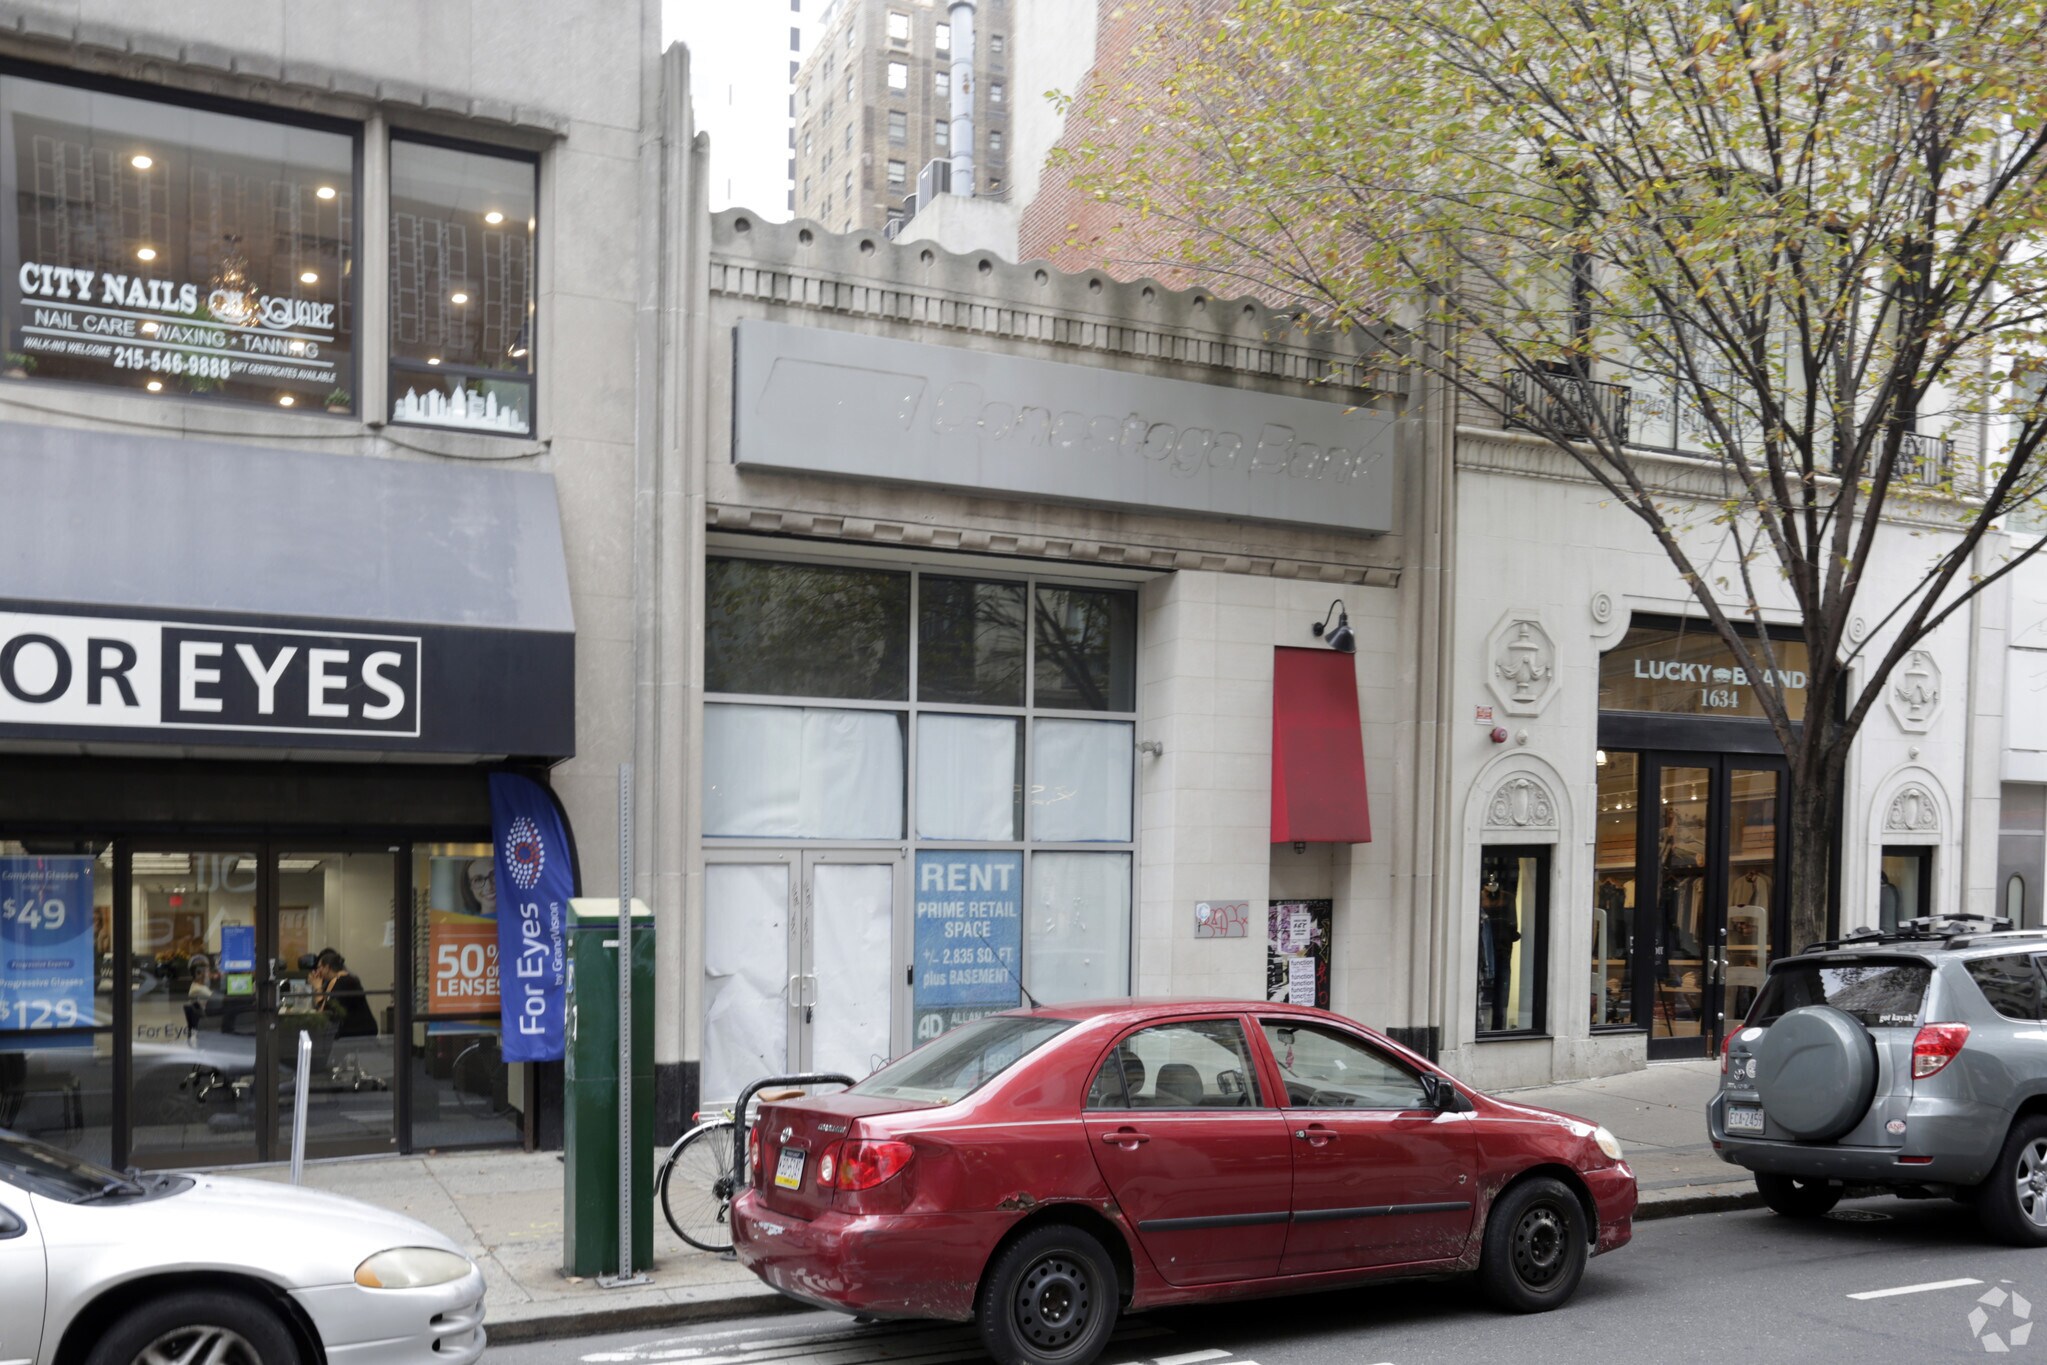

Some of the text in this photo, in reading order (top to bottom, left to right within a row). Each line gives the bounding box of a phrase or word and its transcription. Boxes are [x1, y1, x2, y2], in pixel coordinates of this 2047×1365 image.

[19, 261, 95, 301] CITY
[102, 272, 198, 314] NAILS
[256, 294, 335, 331] SQUARE
[34, 308, 79, 331] NAIL
[83, 314, 136, 337] CARE
[155, 324, 227, 349] WAXING
[23, 336, 113, 358] WALK-INS WELCOME
[114, 346, 231, 380] 215-546-9888
[231, 360, 337, 384] GIFT CERTIFICATES AVAILABLE
[0, 633, 405, 721] OR EYES
[1634, 659, 1807, 690] LUCKY BAND
[1701, 689, 1739, 708] 1634
[920, 863, 1016, 892] RENT
[3, 897, 66, 930] $49
[917, 901, 1017, 919] PRIME RETAIL
[549, 901, 564, 986] by GrandVision
[945, 921, 991, 939] SPACE
[517, 902, 550, 1035] For Eyes
[923, 968, 1009, 989] plus BASEMENT
[0, 997, 78, 1031] $129
[918, 1014, 943, 1040] AD
[1879, 1014, 1891, 1023] got
[138, 1025, 161, 1039] For
